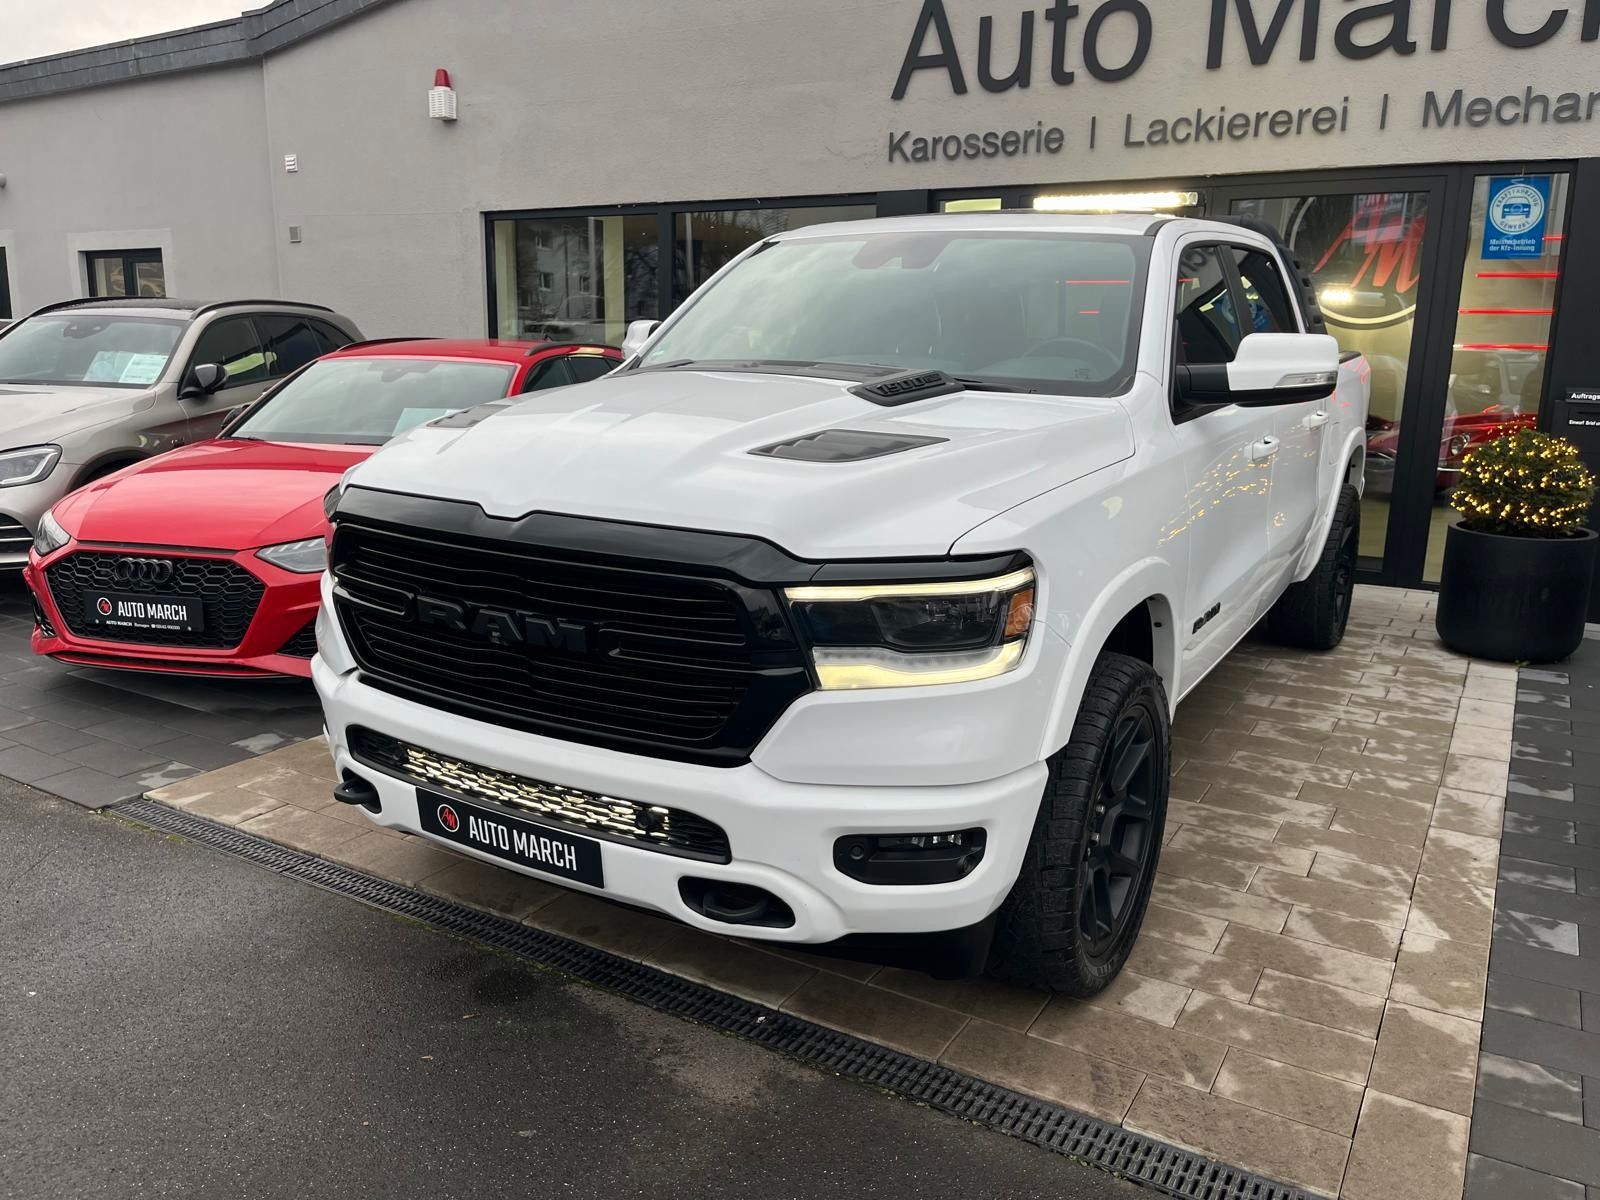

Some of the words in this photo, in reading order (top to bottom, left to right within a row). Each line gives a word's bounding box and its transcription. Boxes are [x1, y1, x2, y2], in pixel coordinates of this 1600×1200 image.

[890, 0, 1153, 101] Auto
[1206, 0, 1600, 69] Marc
[888, 120, 1065, 163] Karosserie
[1124, 96, 1350, 148] Lackiererei
[118, 601, 145, 618] AUTO
[146, 603, 188, 621] MARCH
[416, 595, 588, 653] RAM
[469, 815, 510, 850] AUTO
[513, 829, 578, 871] MARCH
